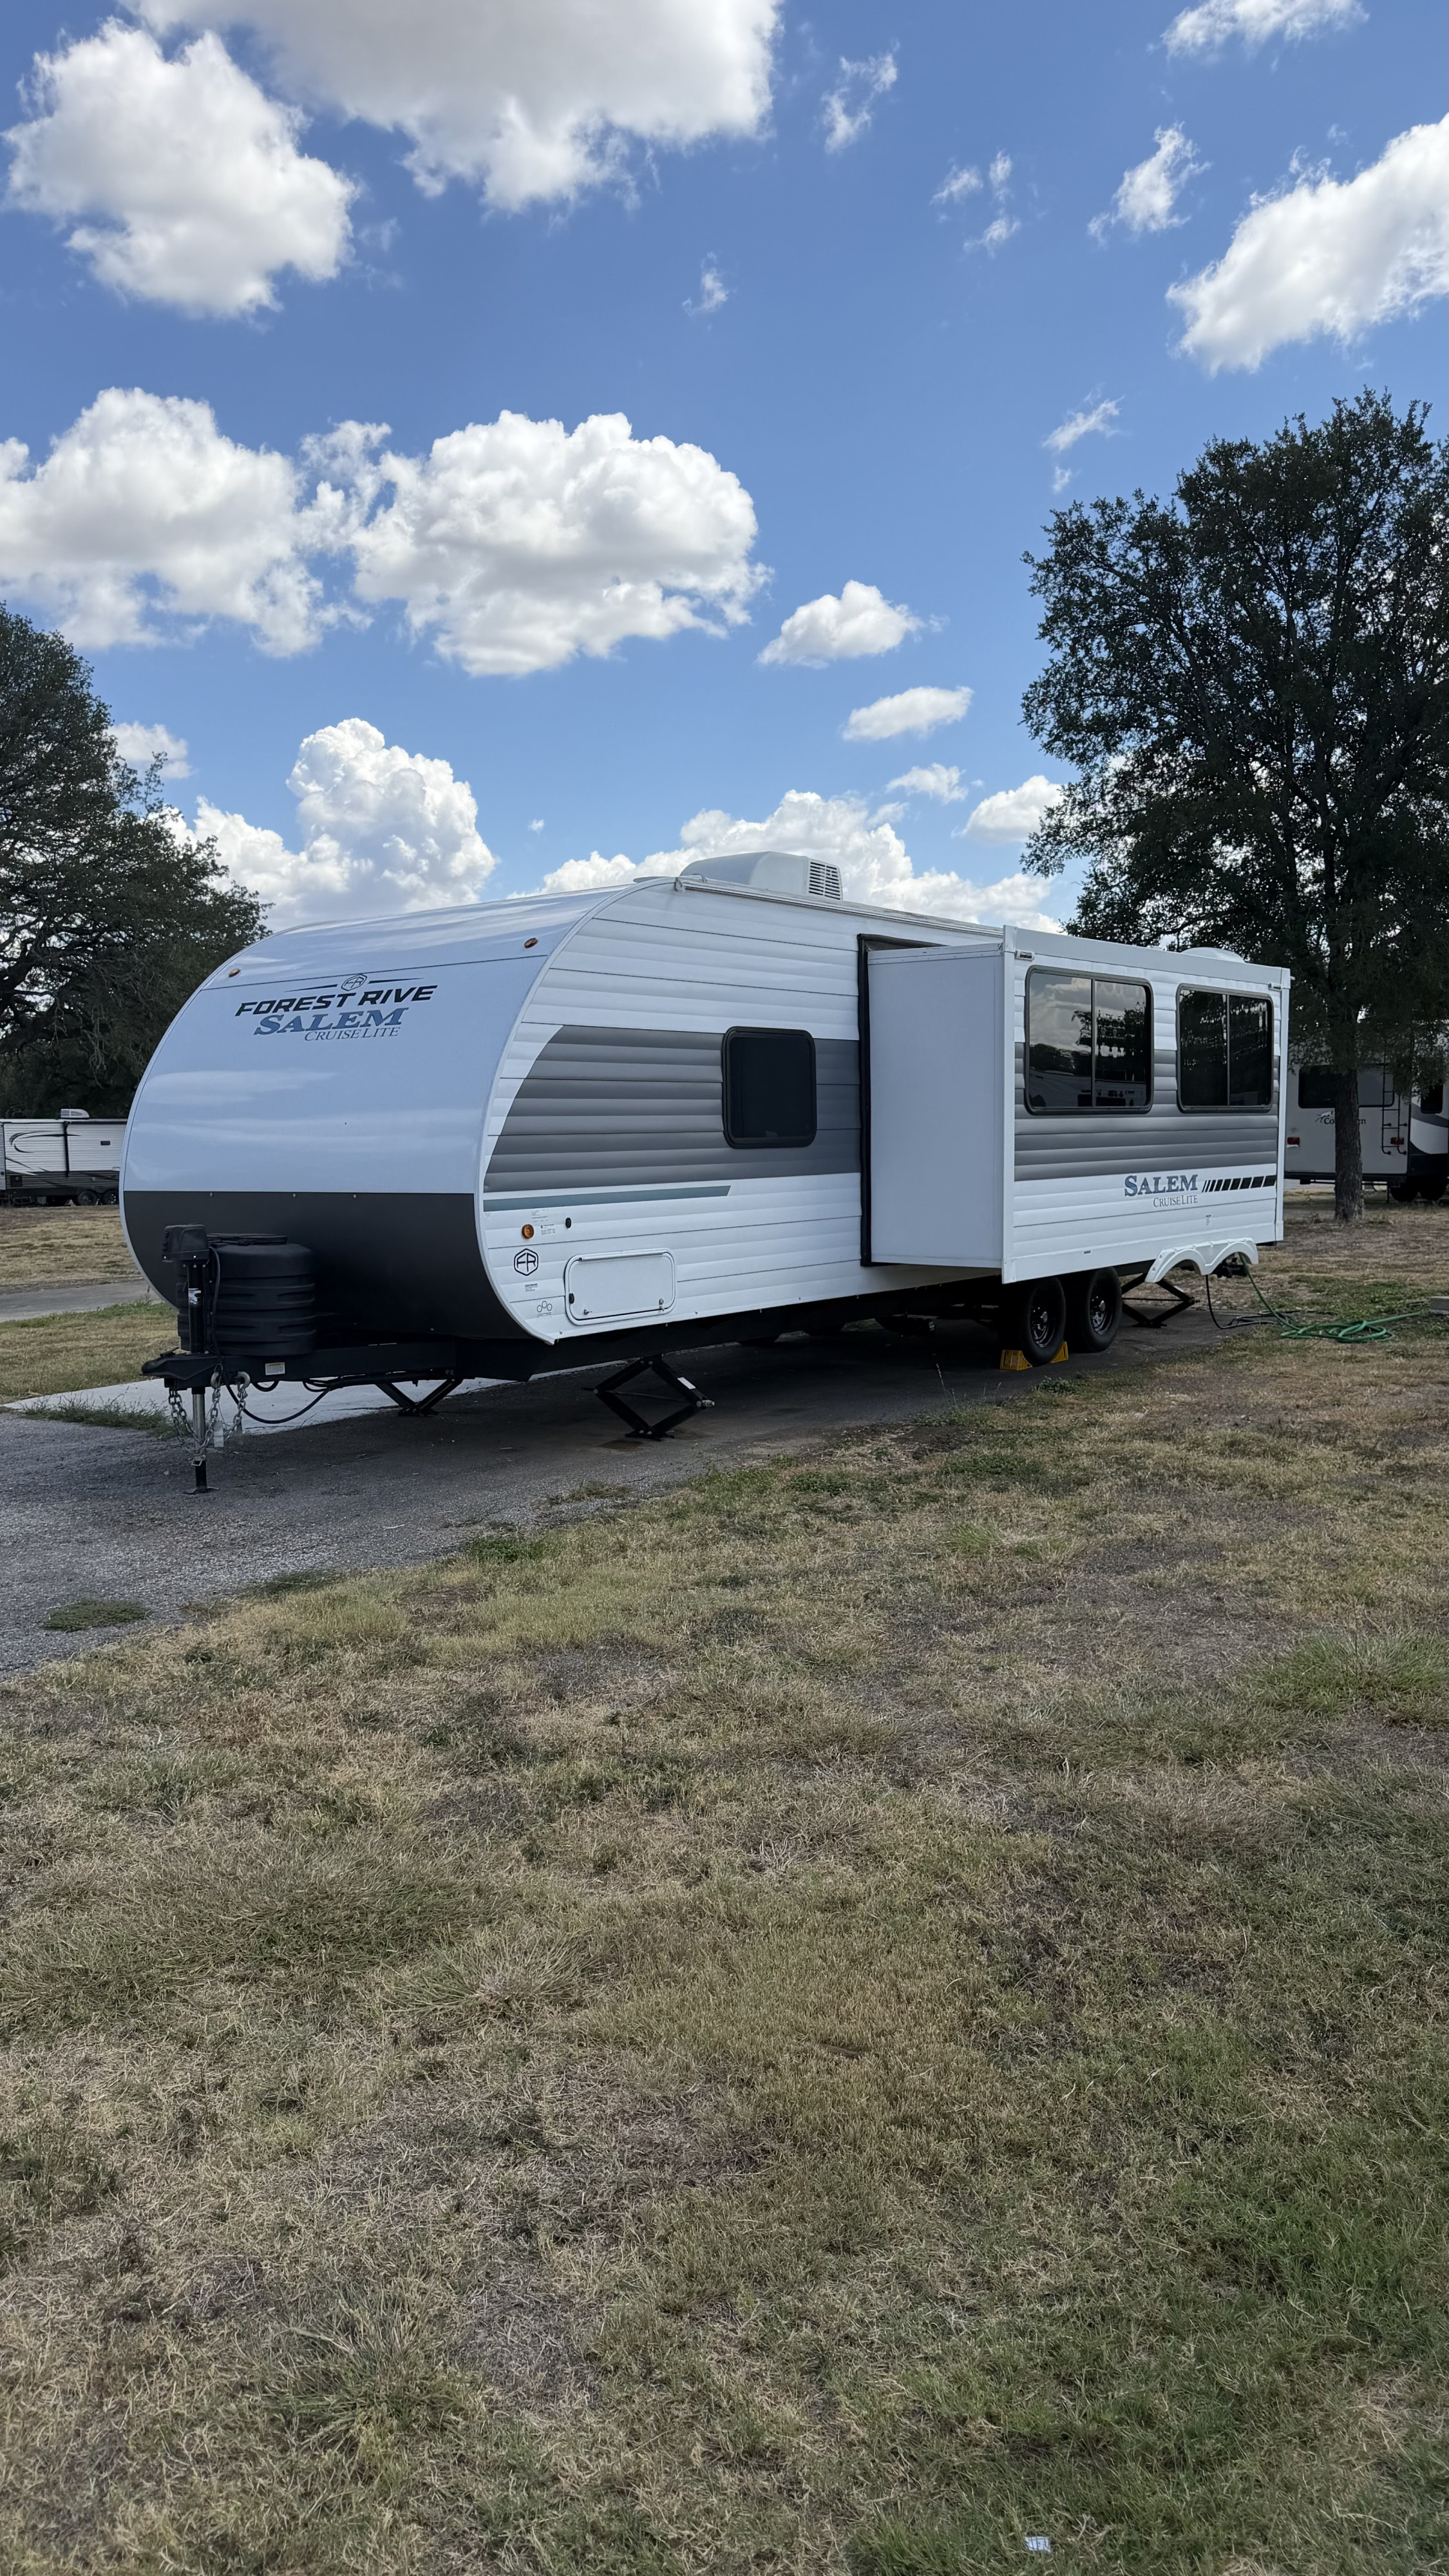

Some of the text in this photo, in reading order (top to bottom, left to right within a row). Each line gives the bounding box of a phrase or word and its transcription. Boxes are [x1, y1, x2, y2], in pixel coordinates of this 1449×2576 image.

[234, 985, 438, 1017] FOREST RIVE
[253, 1007, 410, 1036] SALEM
[1124, 1174, 1198, 1197] SALEM
